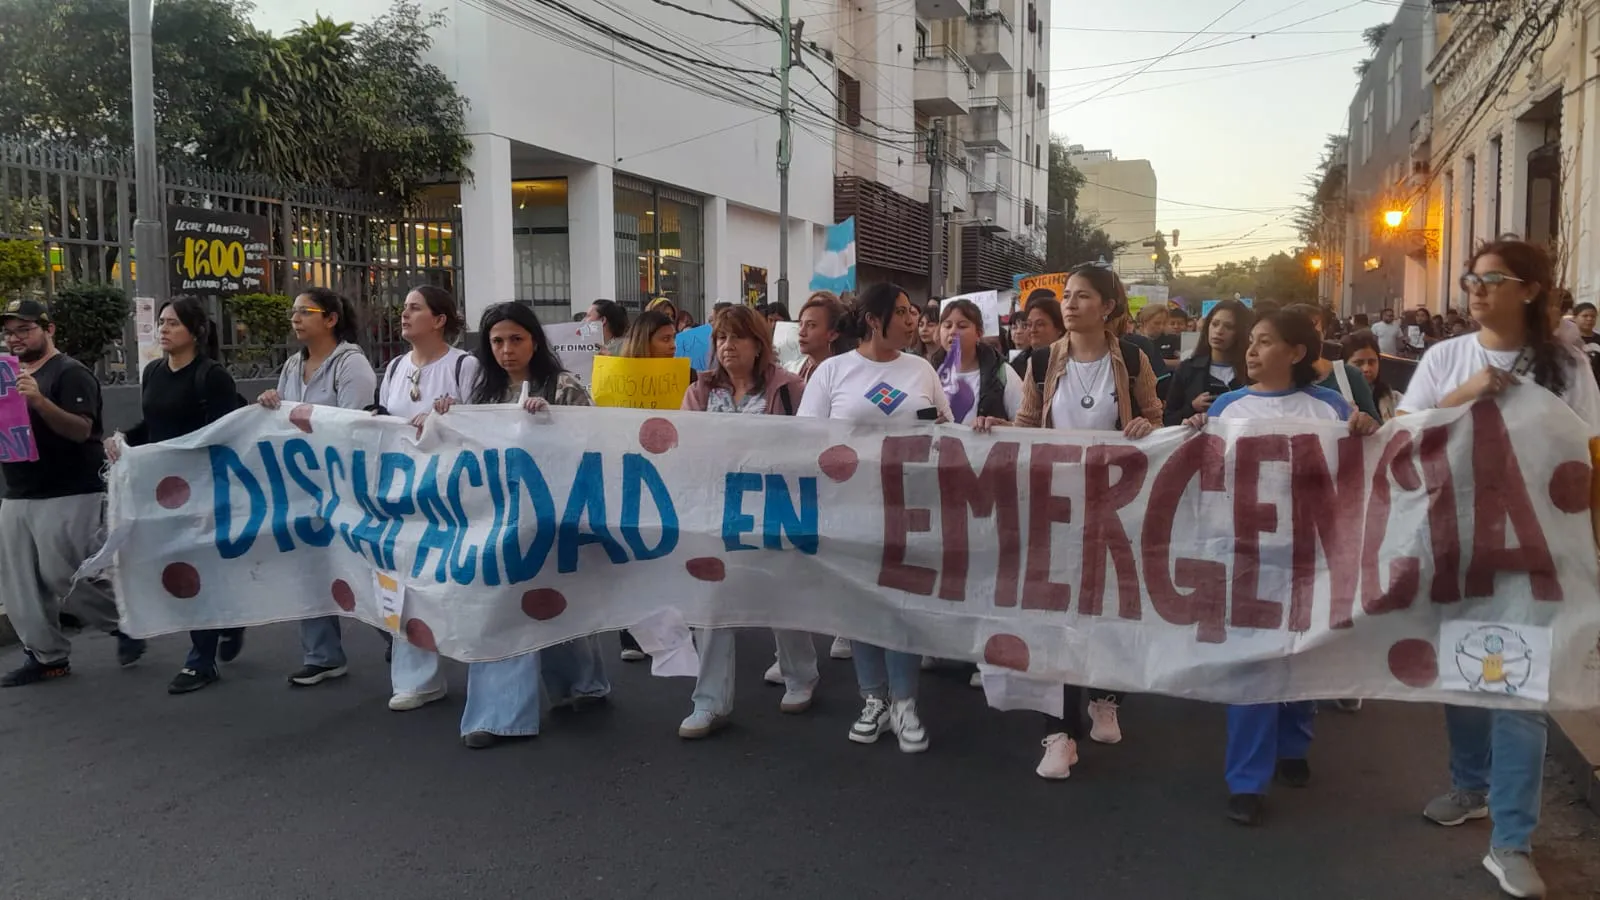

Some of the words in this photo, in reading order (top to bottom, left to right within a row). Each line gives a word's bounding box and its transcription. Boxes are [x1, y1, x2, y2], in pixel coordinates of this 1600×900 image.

[553, 343, 601, 352] PEDIMOS
[208, 438, 680, 586] DISCAPACIDAD
[723, 472, 818, 555] EN
[878, 400, 1564, 642] EMERGENCIA
